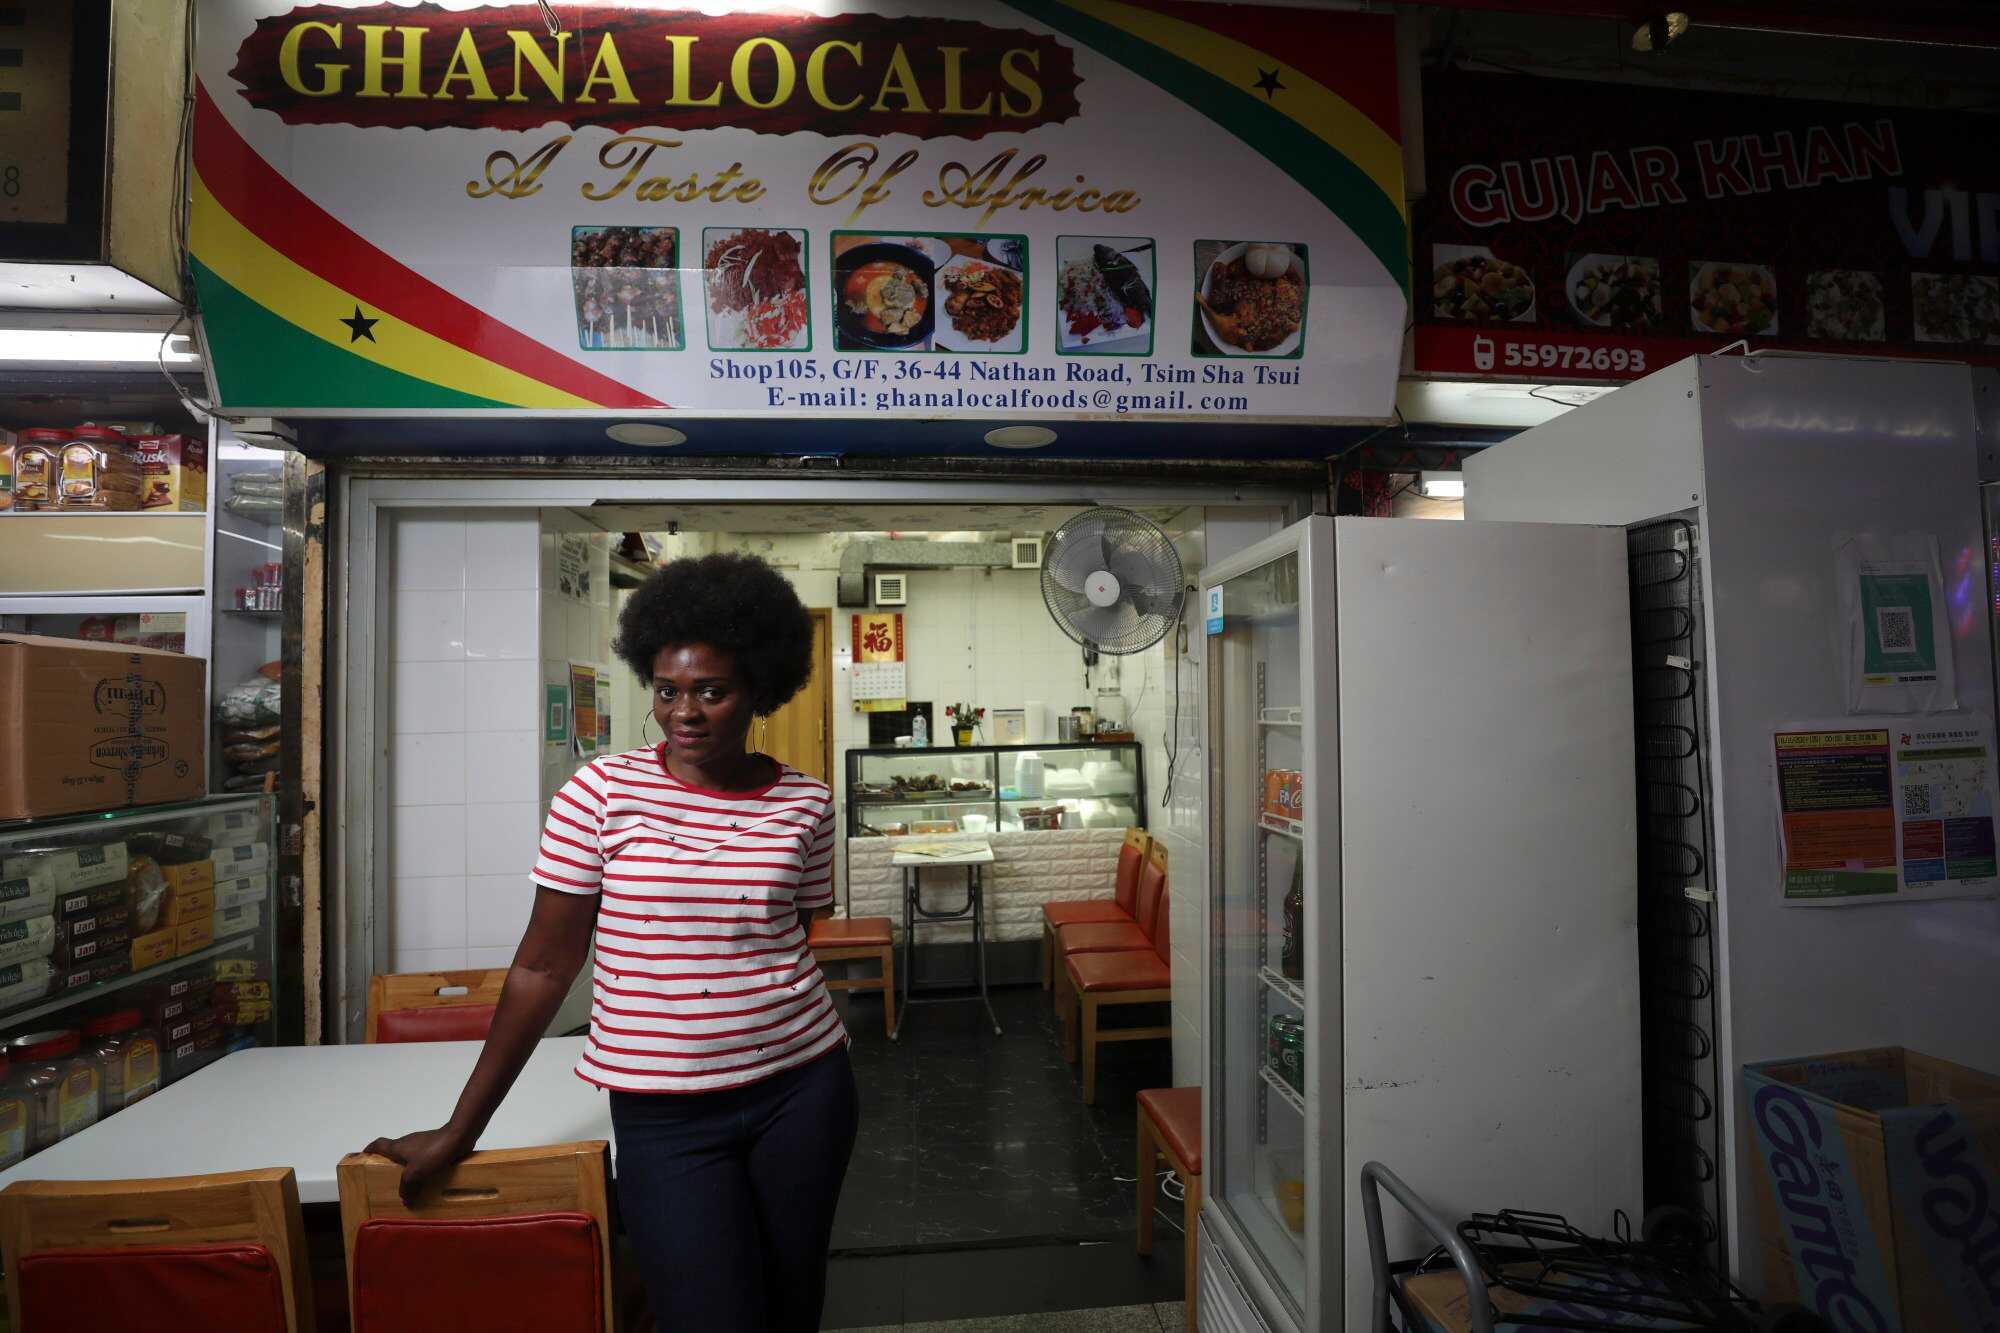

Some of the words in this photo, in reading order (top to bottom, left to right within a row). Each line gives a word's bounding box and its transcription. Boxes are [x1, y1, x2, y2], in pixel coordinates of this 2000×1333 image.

[278, 20, 641, 105] GHANA
[664, 34, 1044, 118] LOCALS
[465, 133, 575, 202] A
[580, 135, 769, 205] Taste
[806, 141, 921, 229] Of
[920, 147, 1142, 231] Africa
[1449, 143, 1688, 228] GUJAR
[1695, 118, 1904, 200] KHAN
[709, 357, 827, 386] Shop105,
[832, 360, 888, 386] G/F,
[893, 361, 963, 382] 36-44
[969, 361, 1059, 383] Nathan
[1066, 362, 1133, 386] Road,
[1141, 363, 1197, 384] Tsim
[1202, 365, 1246, 385] Sha
[1252, 365, 1301, 386] Tsui
[1503, 341, 1647, 373] 55972693
[767, 386, 868, 408] E-mail:
[863, 622, 892, 653] 福
[67, 899, 87, 912] Jan
[76, 919, 95, 934] Jan
[76, 944, 95, 958] Jan
